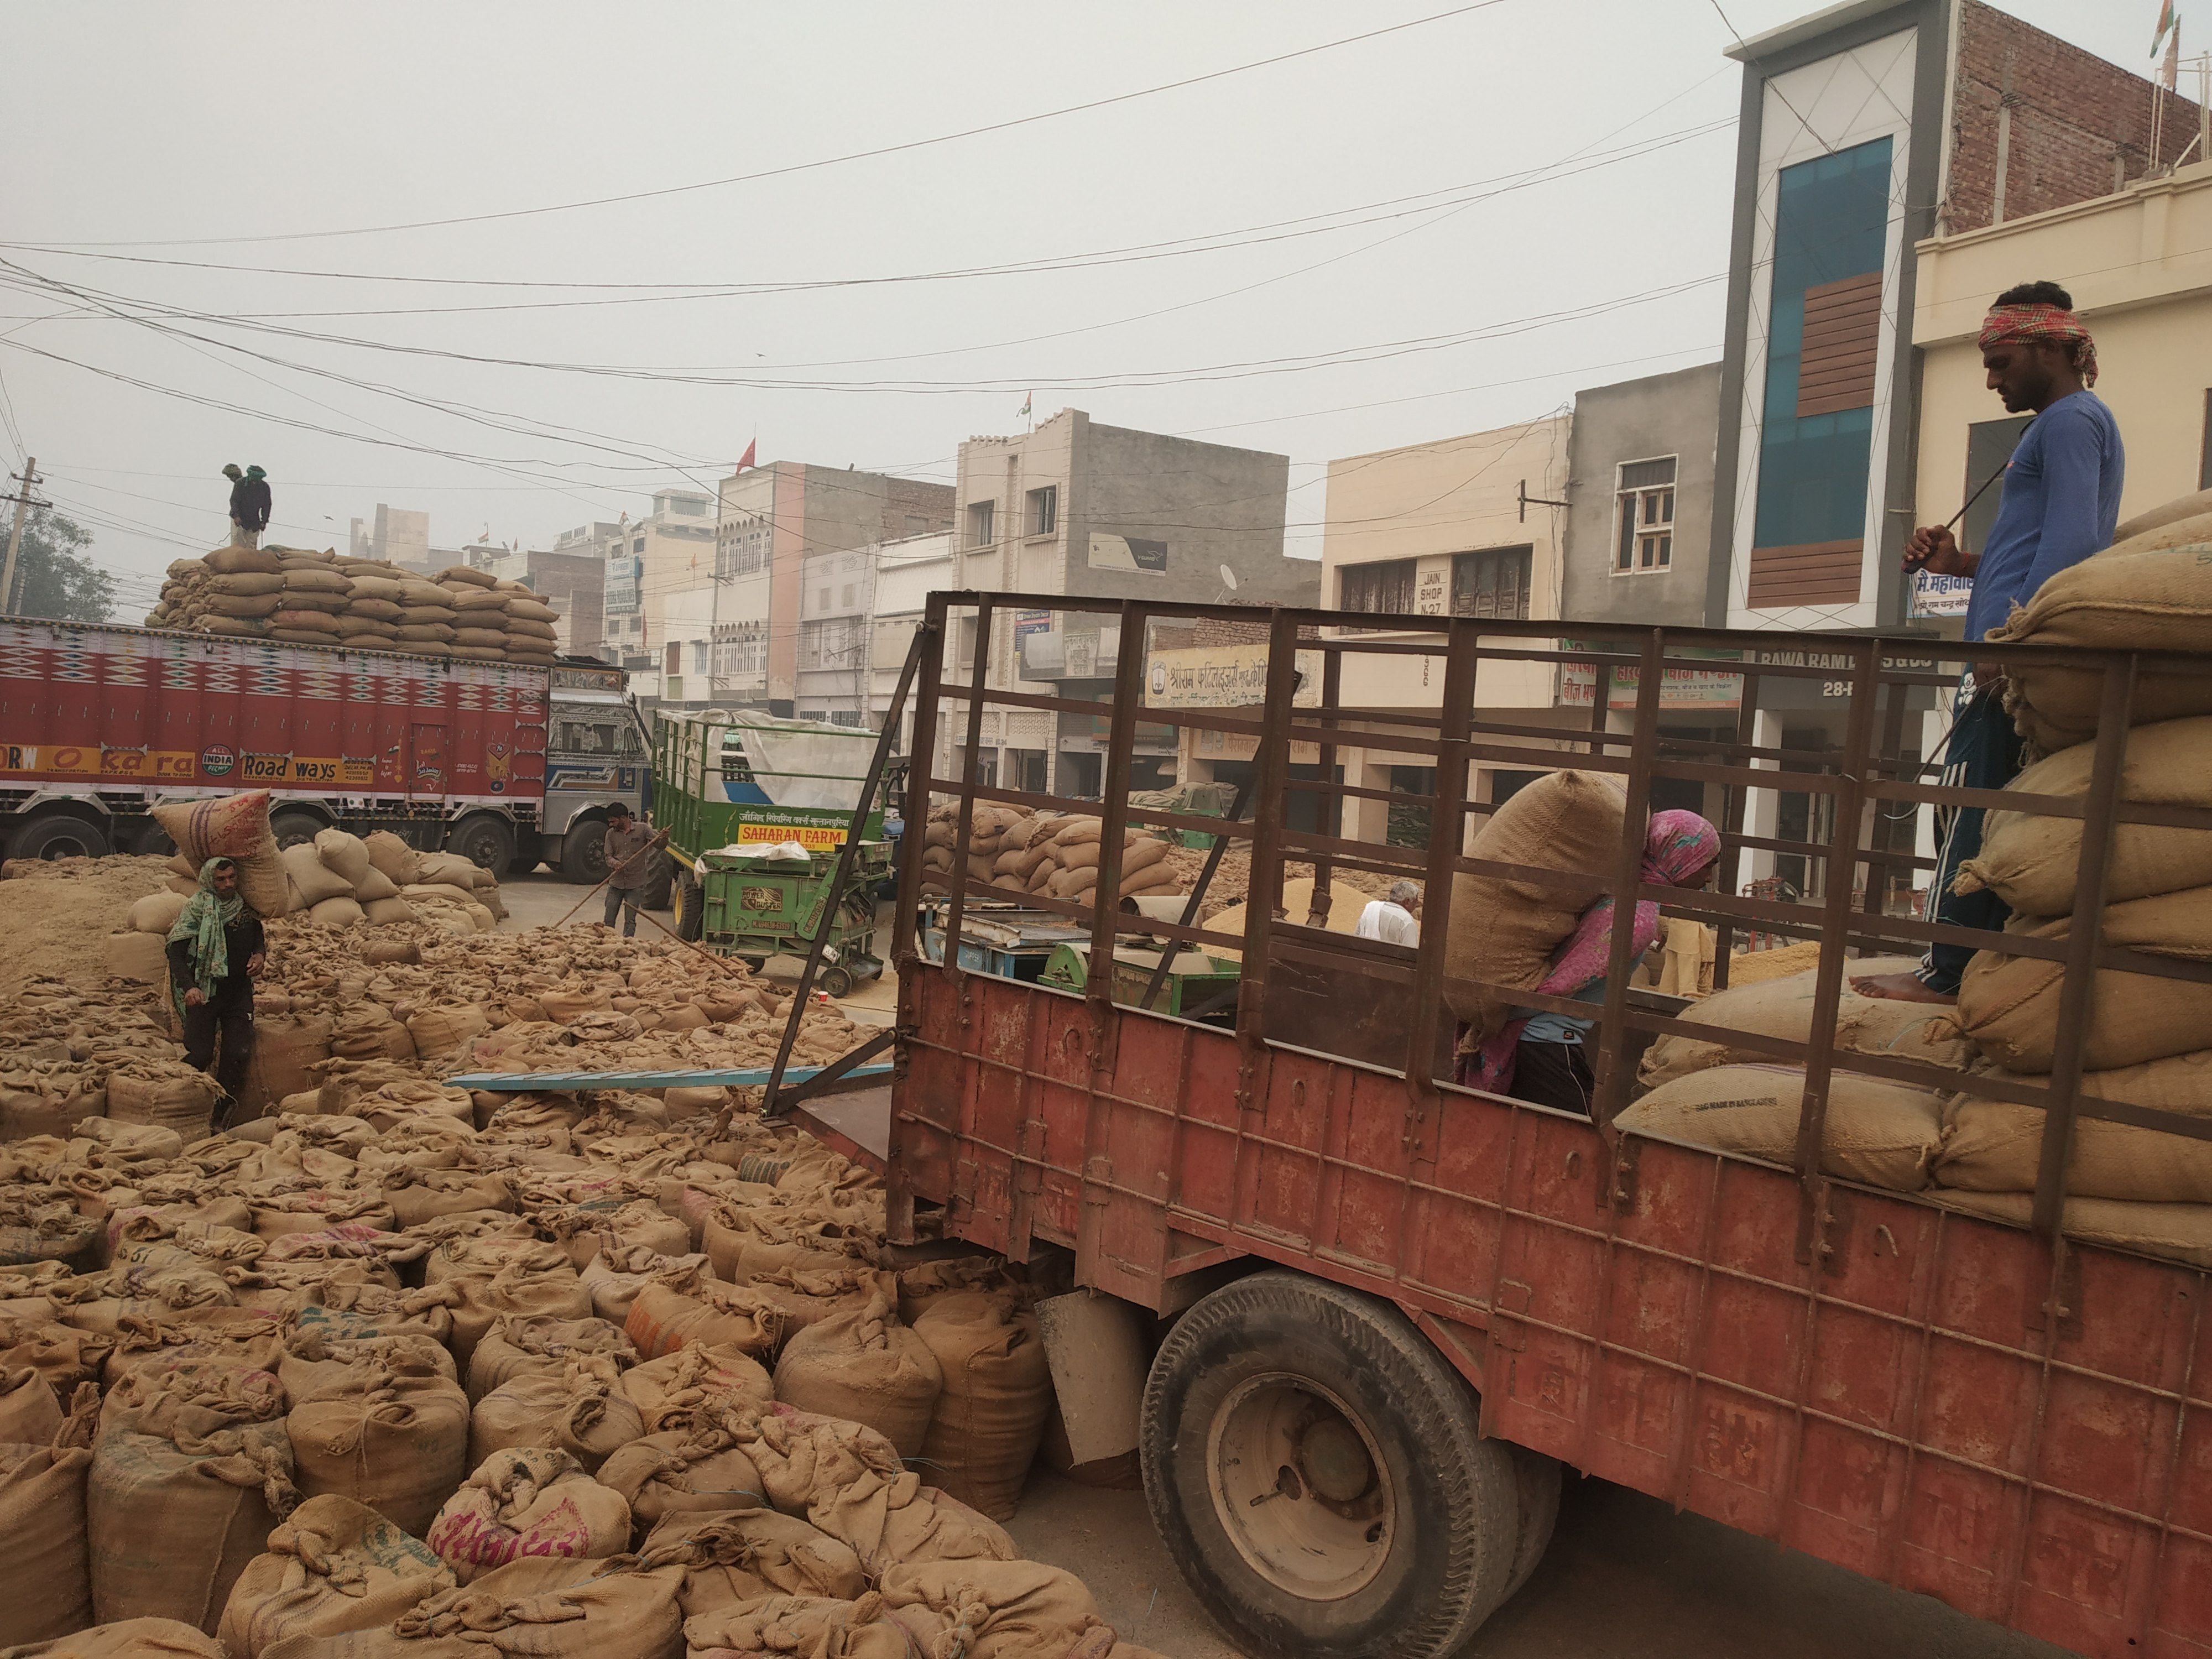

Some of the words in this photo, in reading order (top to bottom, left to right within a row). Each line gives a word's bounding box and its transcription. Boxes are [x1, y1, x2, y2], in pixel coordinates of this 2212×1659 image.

[1424, 573, 1441, 585] JAIN
[1421, 587, 1442, 601] SHOP
[1564, 678, 1582, 701] बीज
[53, 748, 82, 769] O
[156, 757, 193, 773] ra
[244, 755, 290, 776] Road
[295, 763, 336, 780] ways
[204, 755, 232, 764] INDIA
[743, 827, 802, 842] SAHARAN
[805, 830, 842, 844] FARM
[742, 891, 765, 900] POWER
[755, 901, 781, 910] DUSTER
